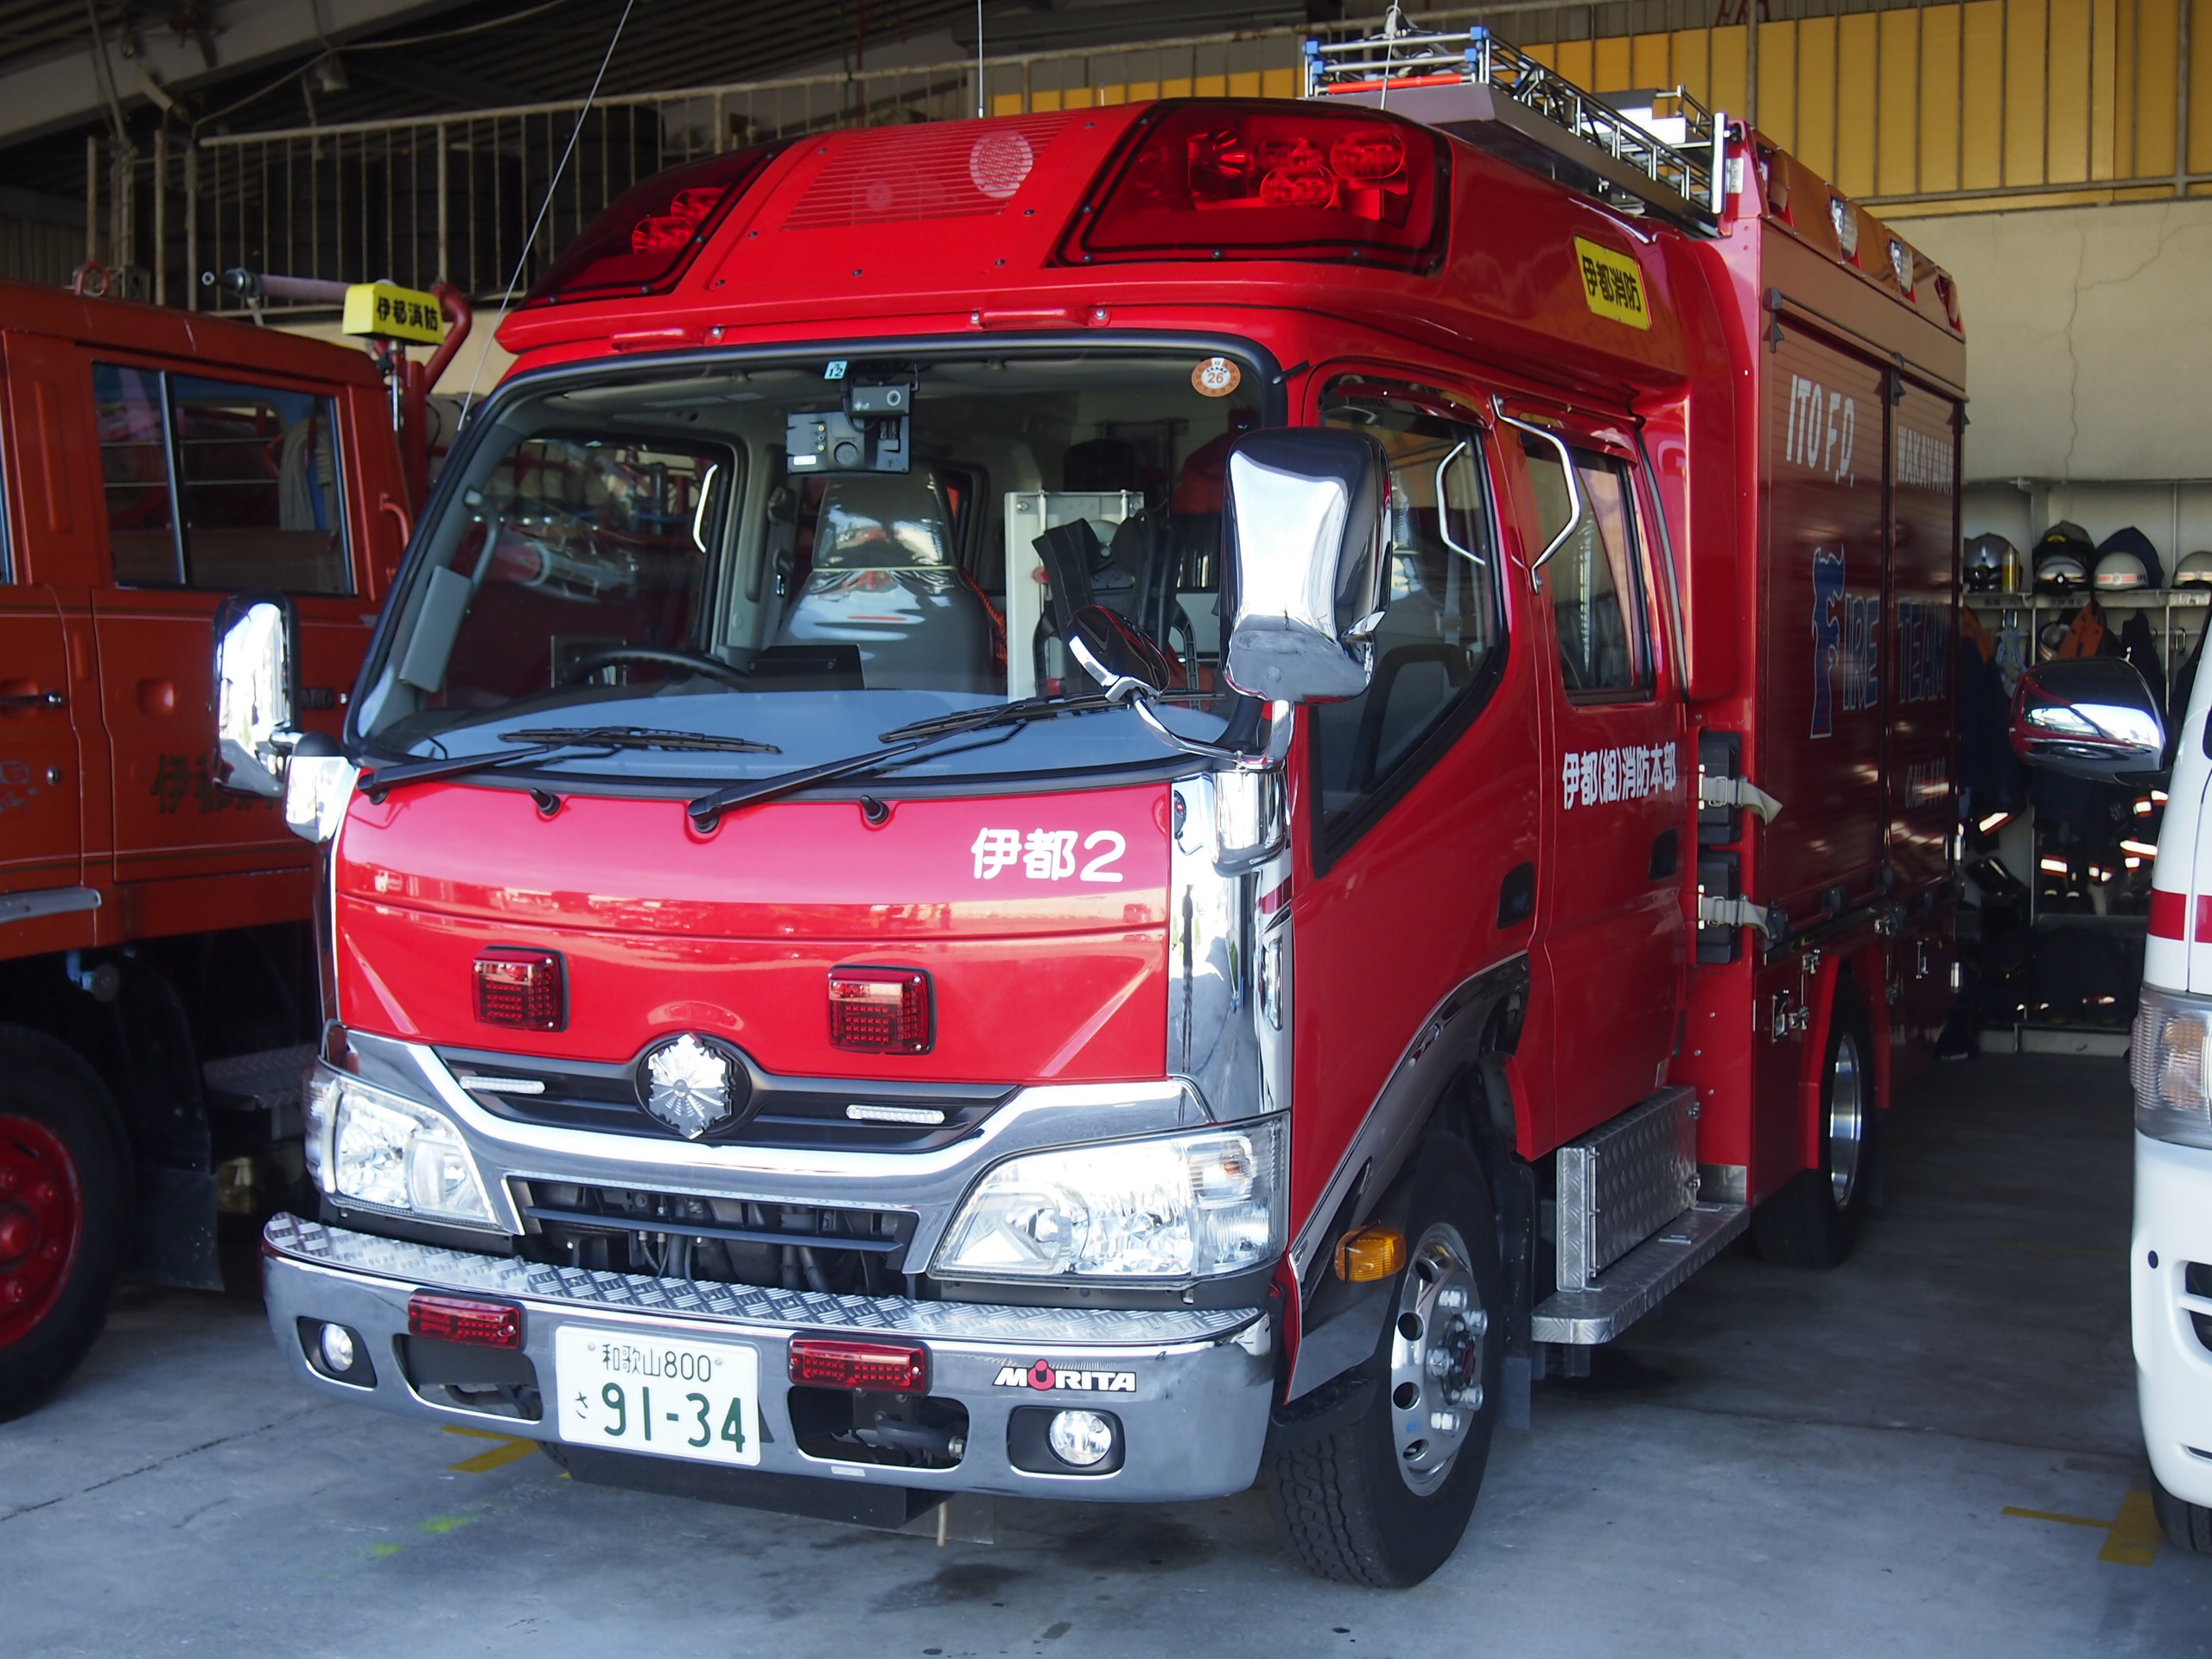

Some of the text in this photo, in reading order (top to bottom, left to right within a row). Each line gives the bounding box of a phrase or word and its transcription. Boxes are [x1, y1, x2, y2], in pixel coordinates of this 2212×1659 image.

[1581, 253, 1642, 313] 伊都消防
[377, 296, 438, 332] 伊都消防
[829, 368, 843, 378] 12
[1207, 372, 1224, 384] 26
[1786, 374, 1822, 468] ITO
[1562, 741, 1676, 810] 伊都(組)消防本部
[970, 827, 1127, 883] 伊都2
[993, 1359, 1137, 1392] MORITA
[575, 1382, 746, 1453] さ 91-34
